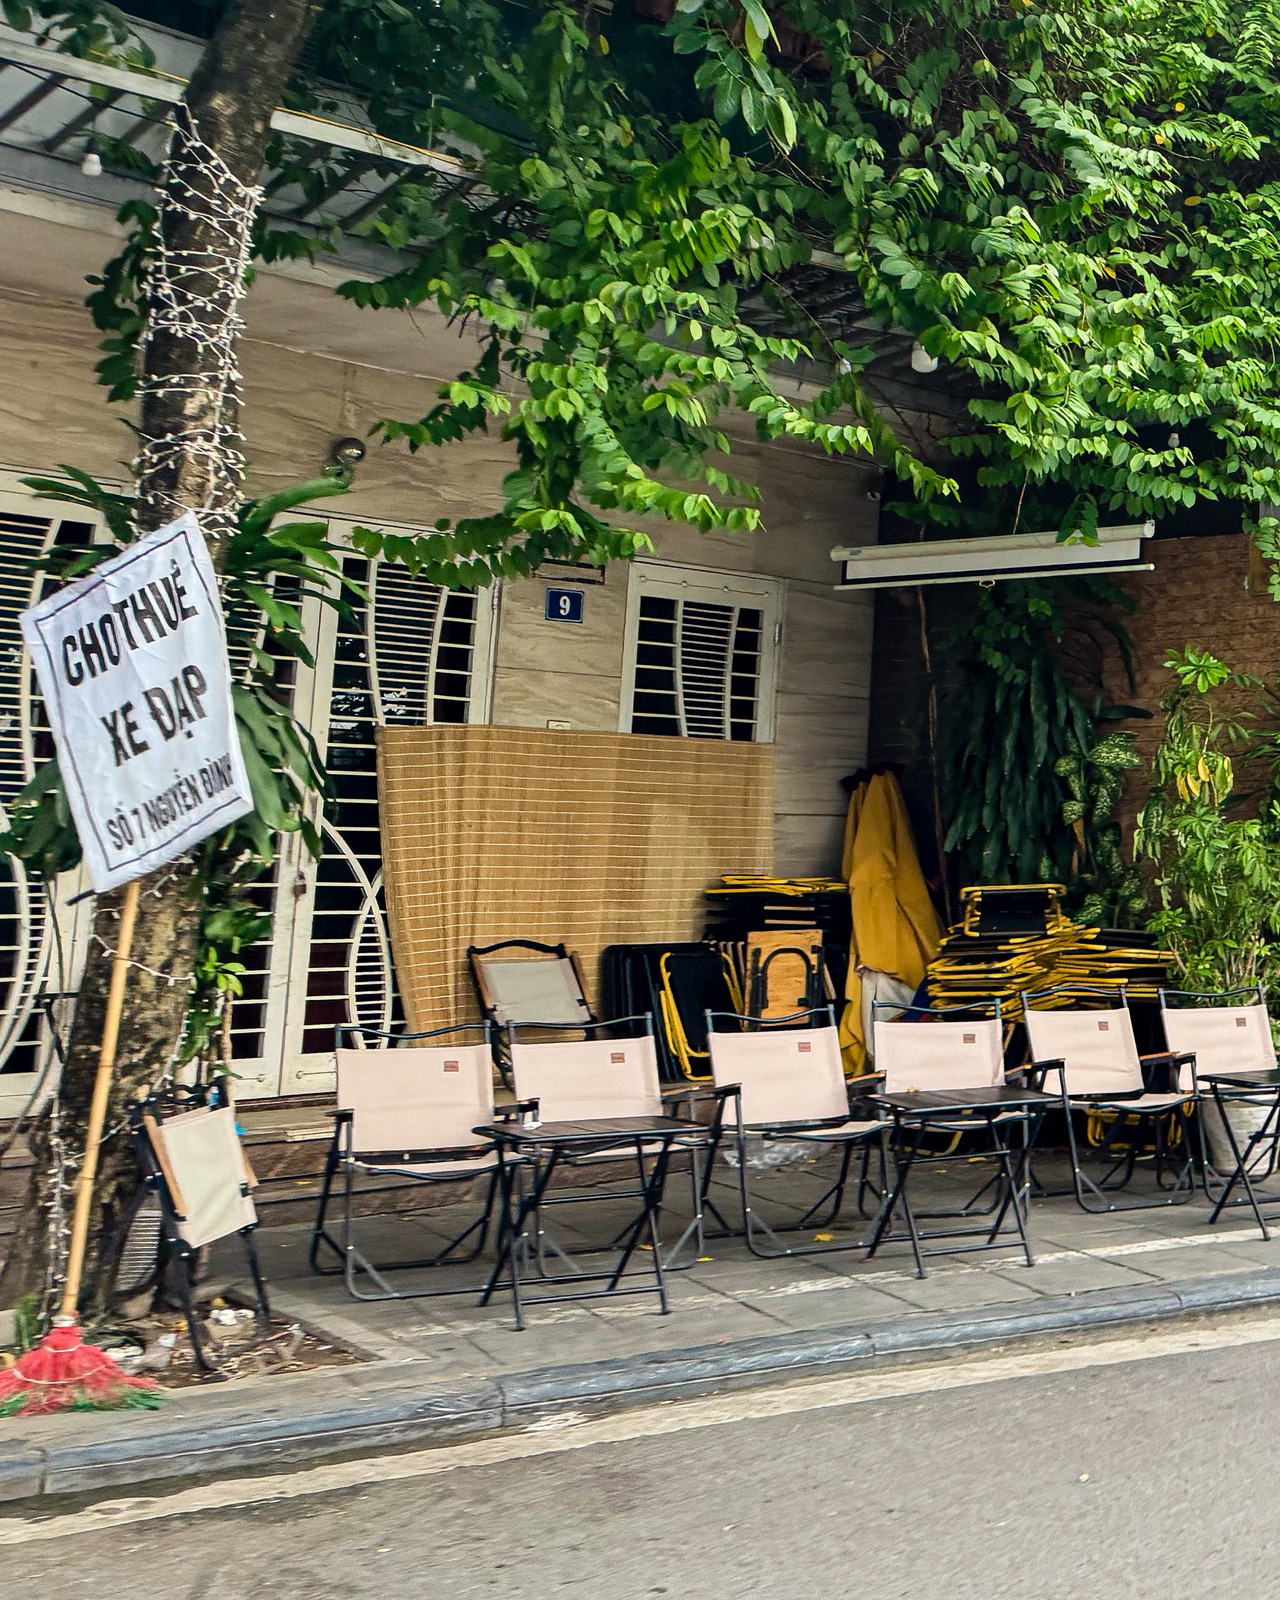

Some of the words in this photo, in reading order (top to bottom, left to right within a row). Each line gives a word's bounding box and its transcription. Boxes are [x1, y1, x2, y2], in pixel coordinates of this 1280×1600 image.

[559, 595, 571, 616] 9
[100, 701, 151, 767] XE
[142, 665, 208, 742] ĐẠP
